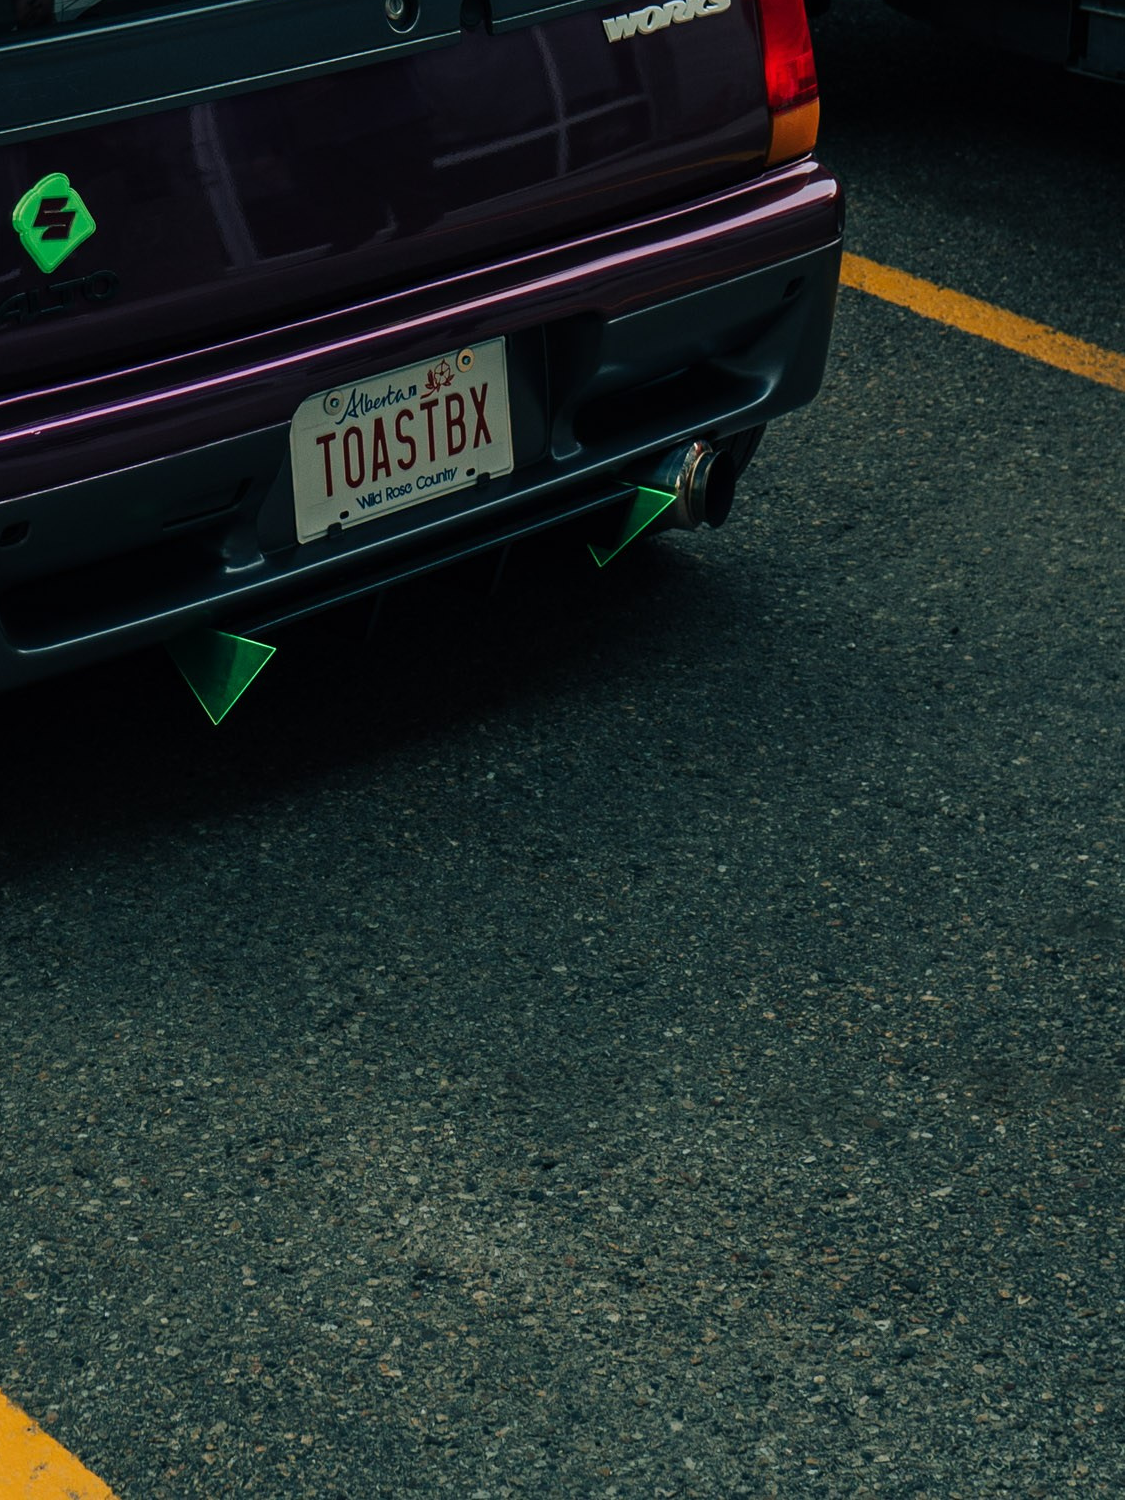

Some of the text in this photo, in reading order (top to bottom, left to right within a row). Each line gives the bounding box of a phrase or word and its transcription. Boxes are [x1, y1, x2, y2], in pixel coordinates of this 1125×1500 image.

[335, 384, 416, 425] Alberta
[316, 382, 493, 498] TOASTBX
[356, 466, 459, 510] Wild Rose Country
